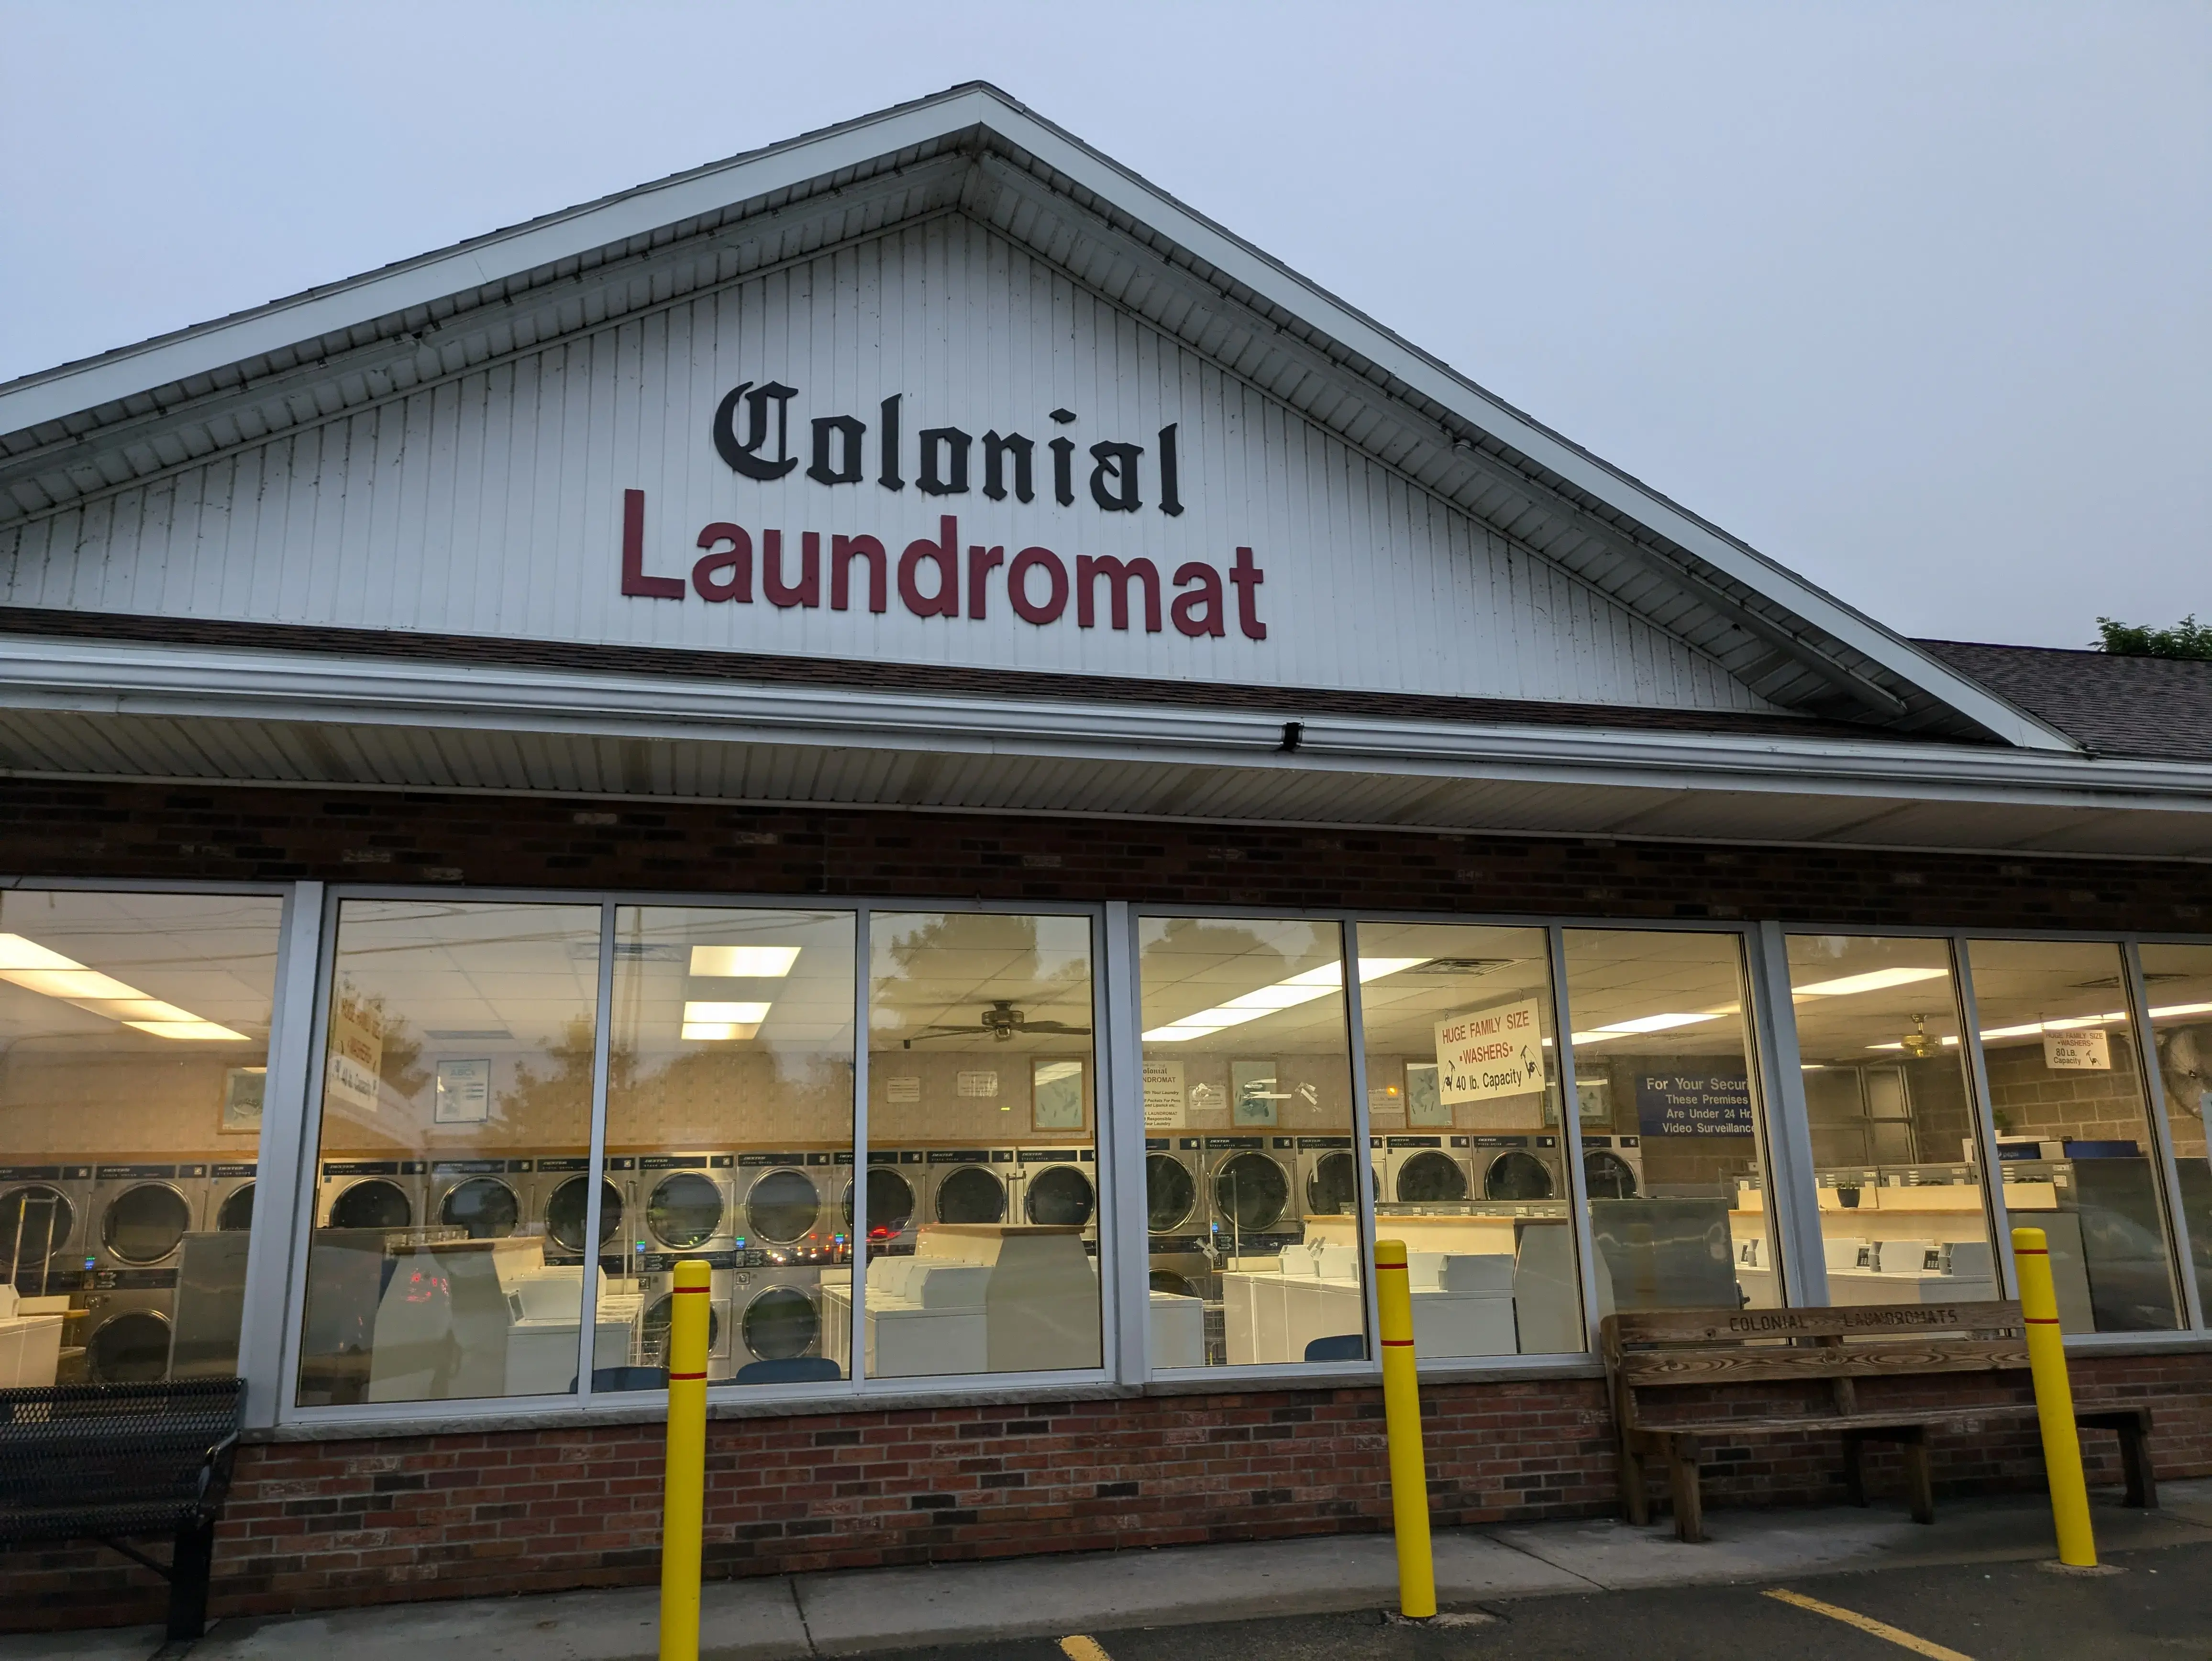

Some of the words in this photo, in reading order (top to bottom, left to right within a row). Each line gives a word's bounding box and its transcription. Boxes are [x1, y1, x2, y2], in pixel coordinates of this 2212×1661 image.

[712, 380, 1184, 517] Colonial
[620, 488, 1267, 640] Laundromat
[1442, 1025, 1466, 1044] HUGE
[1470, 1017, 1501, 1038] FAMILY
[1507, 1010, 1530, 1030] SIZE
[2056, 1048, 2066, 1056] 80
[2053, 1056, 2081, 1066] Capacity
[1456, 1078, 1467, 1091] 40
[1470, 1074, 1480, 1091] lb.
[1482, 1069, 1522, 1091] Capacity
[1646, 1077, 1669, 1090] For
[1675, 1077, 1704, 1090] Your
[1710, 1078, 1749, 1090] Securi
[1665, 1094, 1698, 1104] These
[1702, 1094, 1748, 1105] Premises
[1667, 1108, 1684, 1118] Are
[1689, 1108, 1719, 1118] Under
[1724, 1109, 1735, 1118] 24
[1662, 1122, 1692, 1133] Video
[1729, 1315, 1809, 1331] COLONIAL
